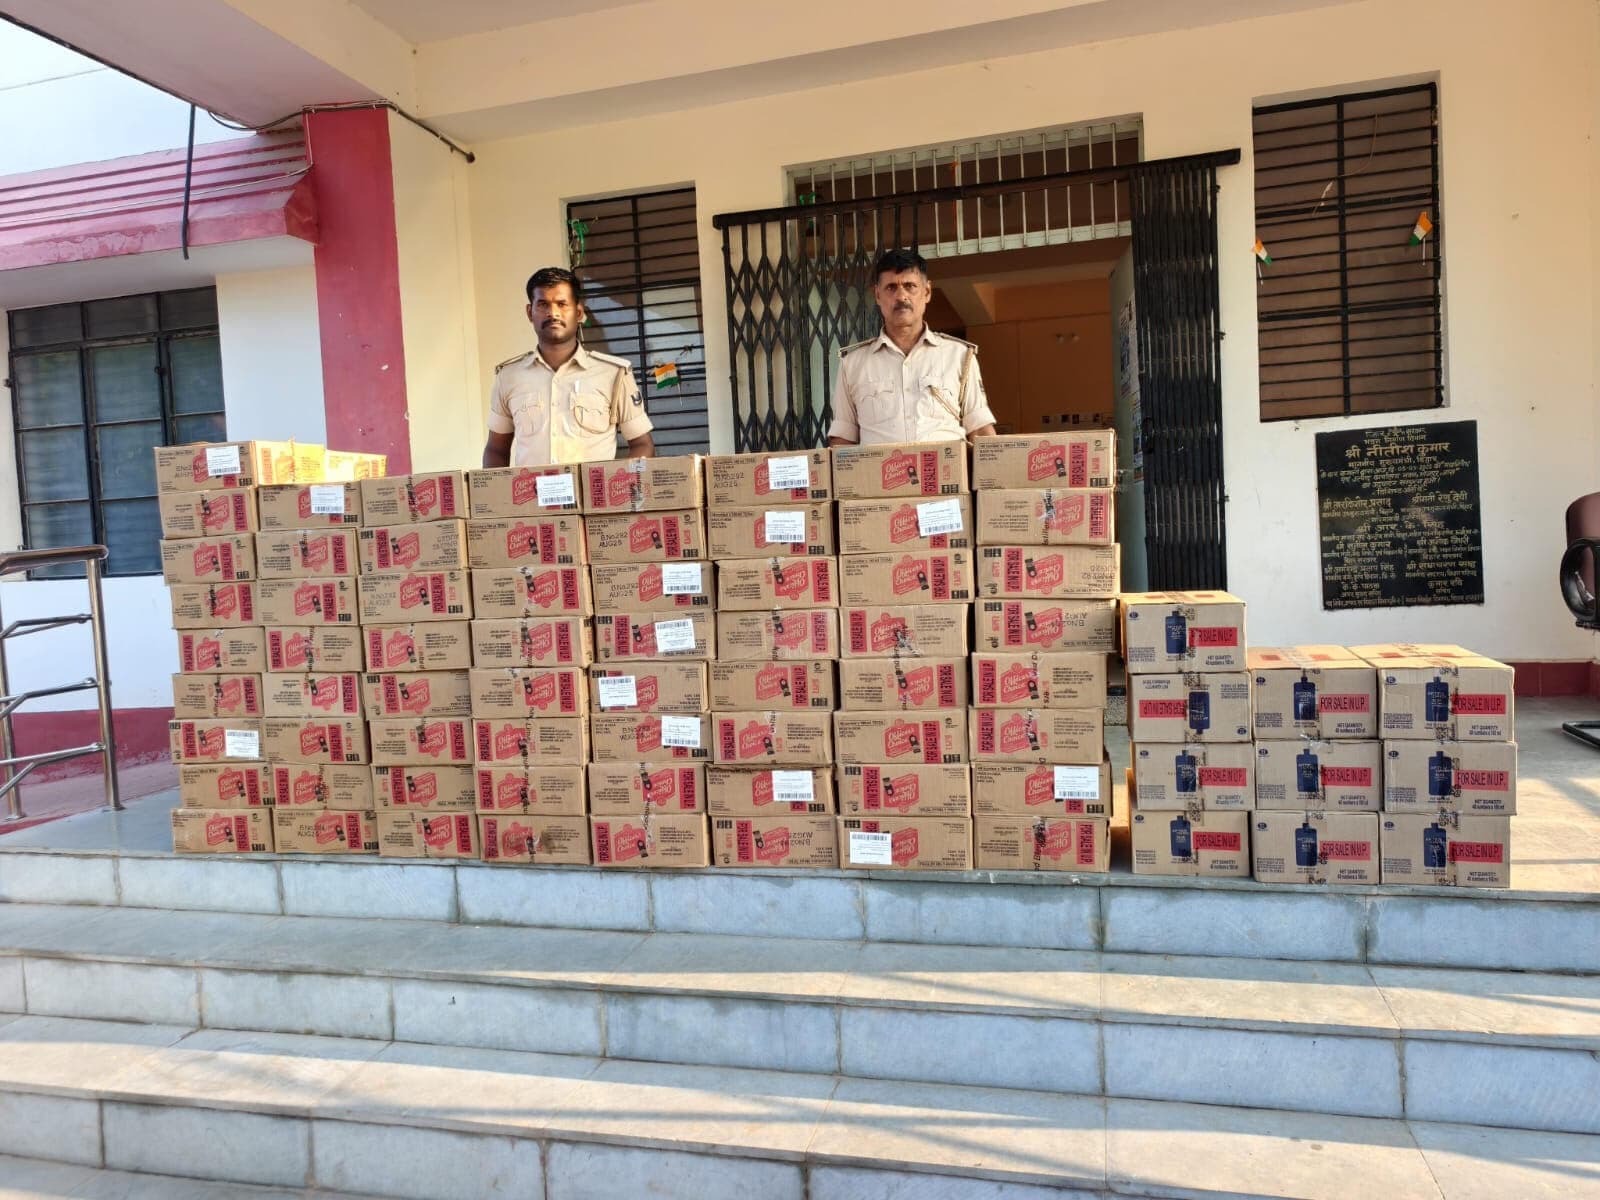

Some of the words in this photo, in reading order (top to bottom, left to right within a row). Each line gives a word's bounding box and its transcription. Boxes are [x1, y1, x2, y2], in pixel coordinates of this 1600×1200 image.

[1346, 446, 1361, 459] श्री
[1367, 444, 1414, 457] नीतीश
[1417, 443, 1450, 457] कुमार
[1321, 697, 1332, 710] FOR
[1334, 697, 1347, 709] SALE
[1349, 697, 1355, 709] IN
[1467, 698, 1482, 711] SALE
[1484, 698, 1489, 710] IN
[1201, 769, 1211, 781] FOR
[1212, 769, 1226, 782] SALE
[1227, 770, 1233, 782] IN
[1324, 769, 1335, 781] FOR
[1336, 769, 1351, 782] SALE
[1352, 769, 1357, 782] IN
[1457, 772, 1469, 785] FOR
[1471, 772, 1486, 785] SALE
[1487, 773, 1493, 785] IN
[1195, 834, 1207, 847] FOR
[1208, 834, 1221, 847] SALE
[1222, 834, 1228, 847] IN
[1322, 843, 1334, 856] FOR
[1336, 843, 1349, 856] SALE
[1351, 843, 1356, 856] IN
[1452, 844, 1464, 857] FOR
[1466, 844, 1480, 857] SALE
[1482, 844, 1487, 857] IN
